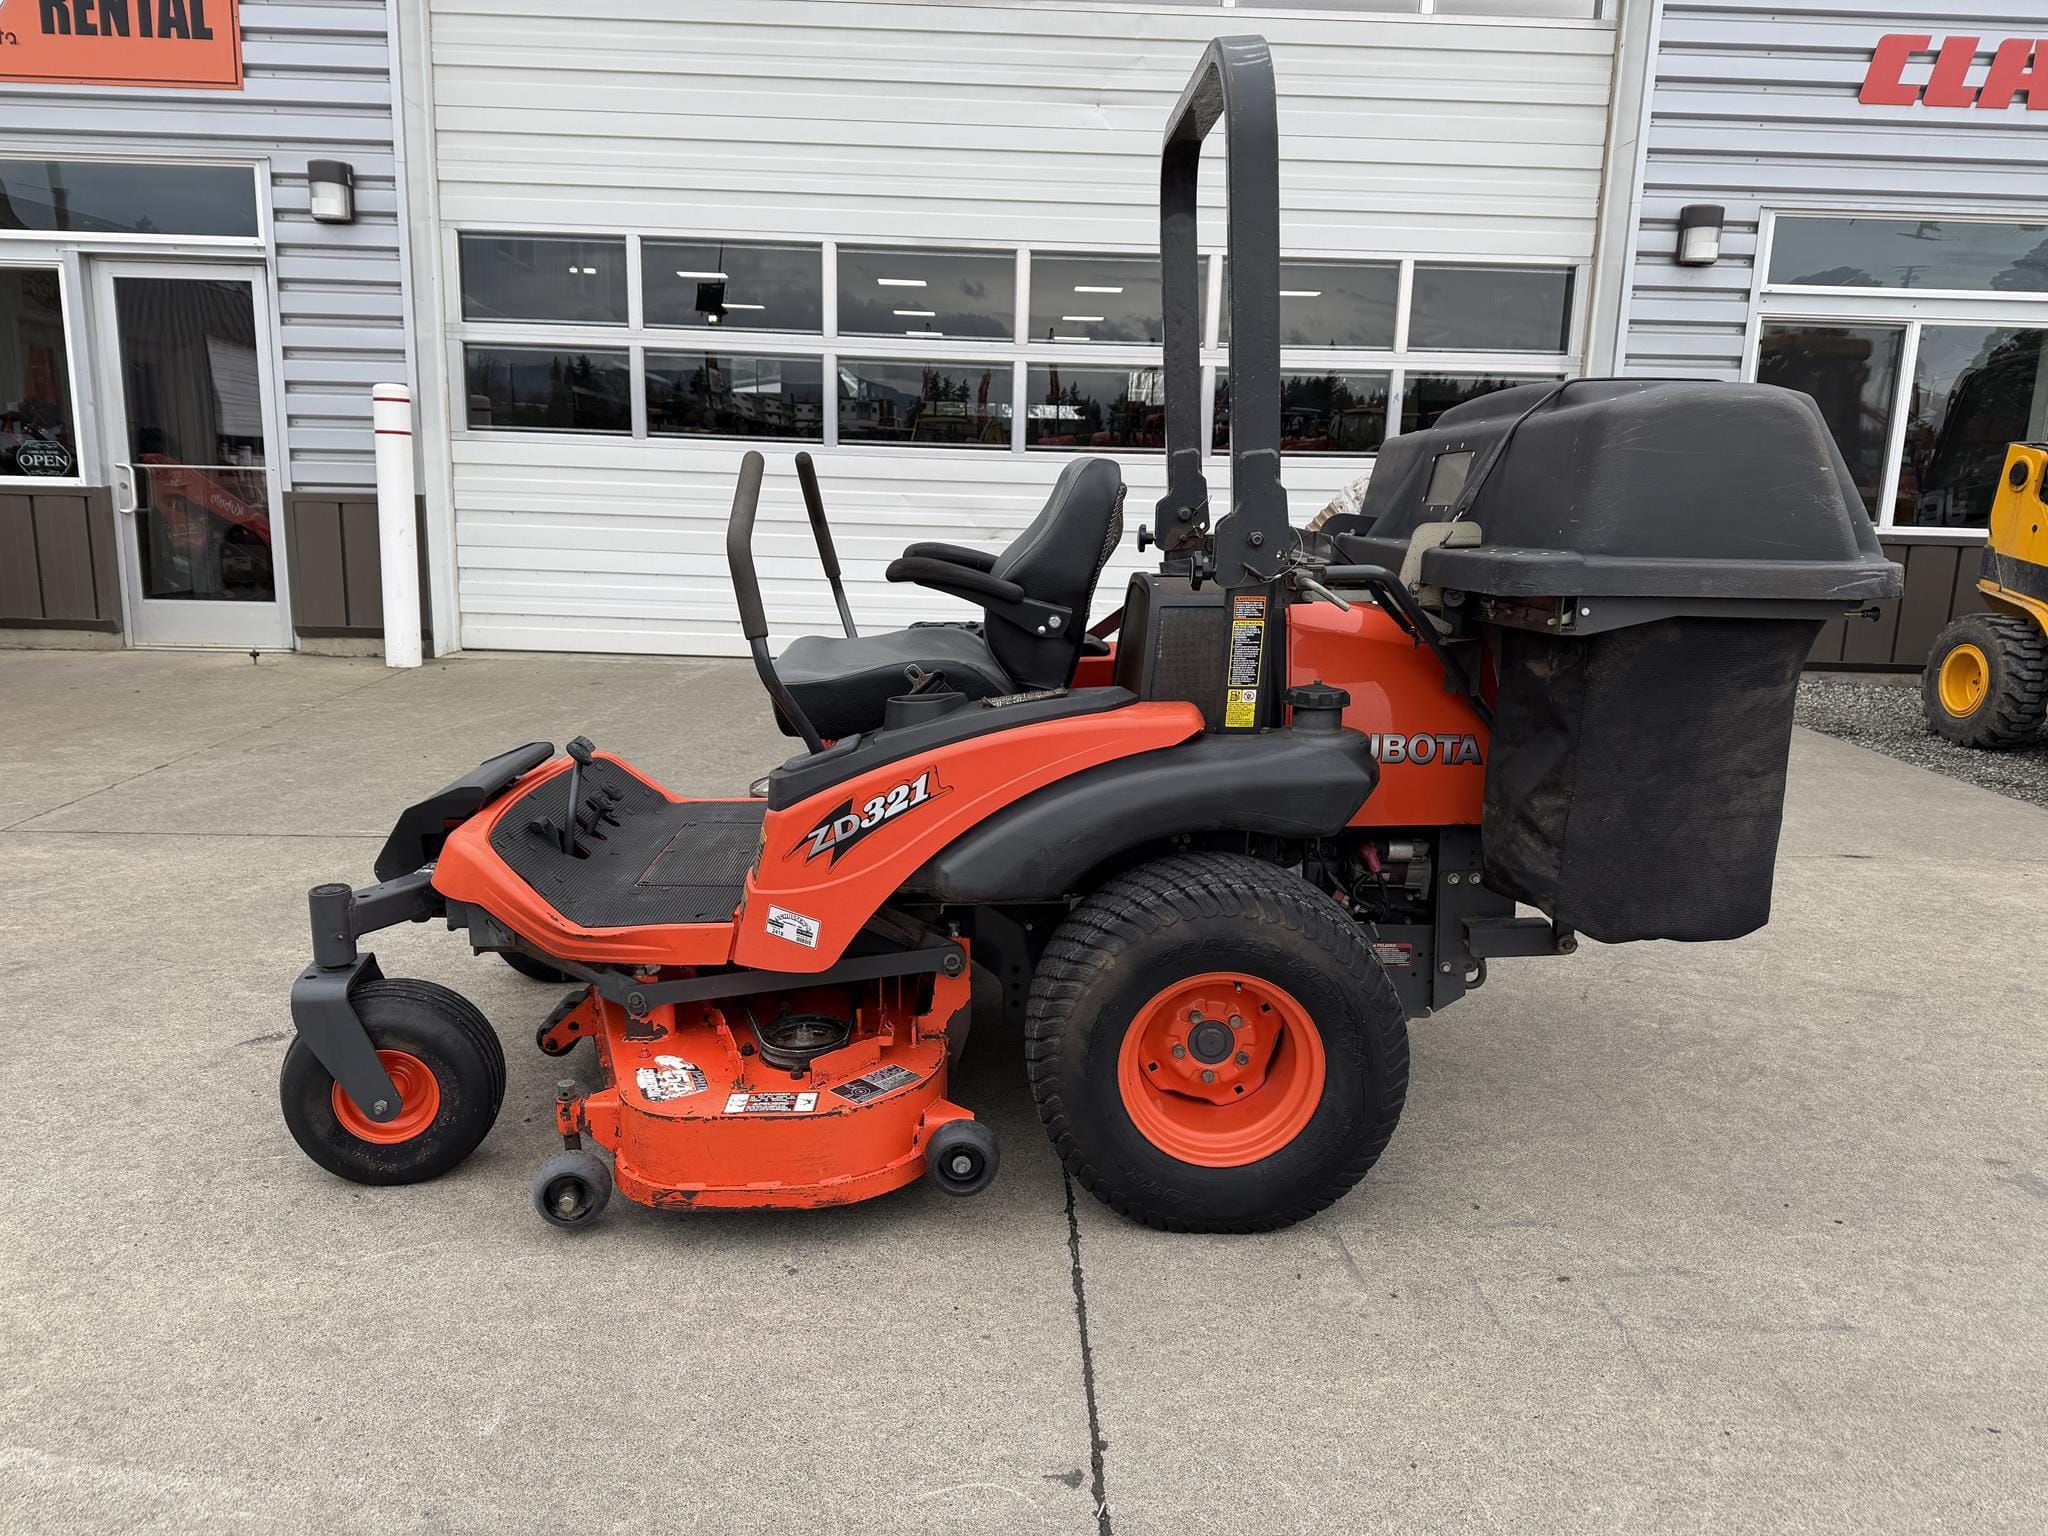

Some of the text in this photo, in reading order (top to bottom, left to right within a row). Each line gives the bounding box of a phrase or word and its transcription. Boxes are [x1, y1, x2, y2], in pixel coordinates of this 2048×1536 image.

[1858, 33, 2048, 110] CLA
[20, 454, 68, 466] OPEN
[807, 771, 931, 862] ZD321
